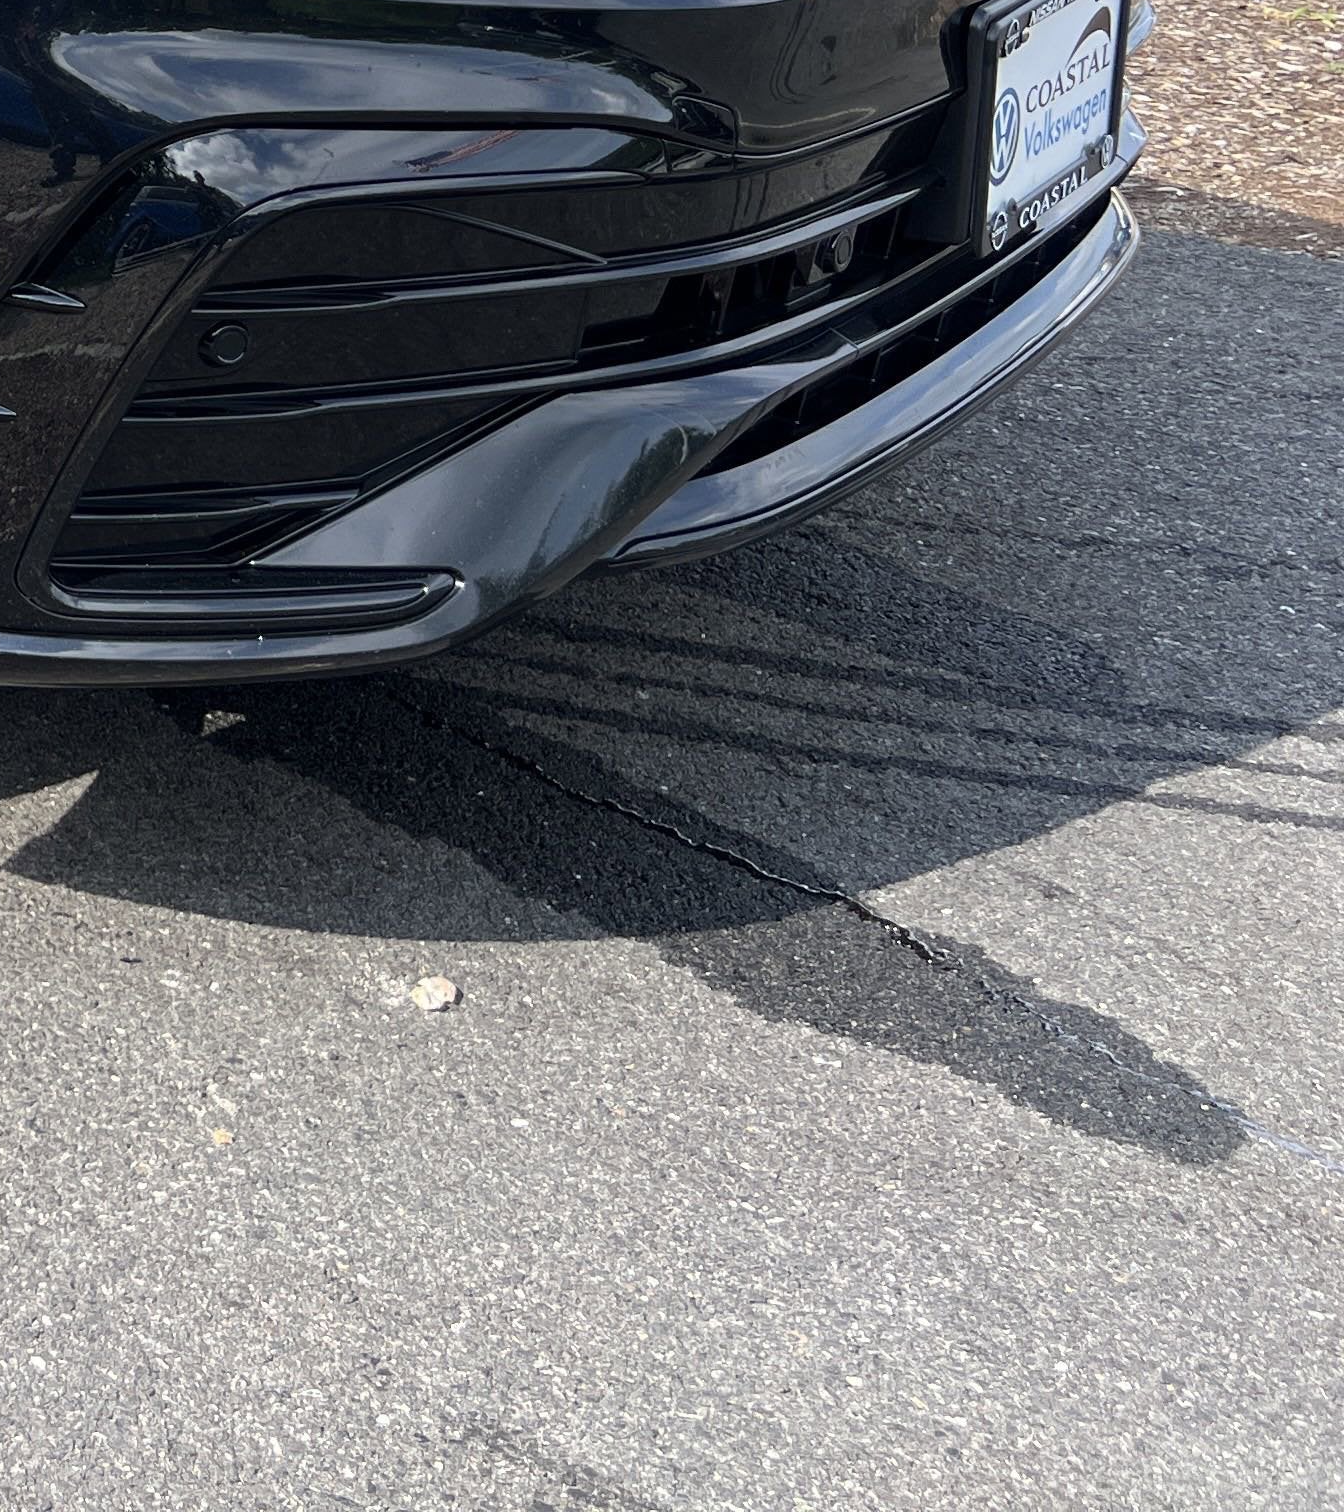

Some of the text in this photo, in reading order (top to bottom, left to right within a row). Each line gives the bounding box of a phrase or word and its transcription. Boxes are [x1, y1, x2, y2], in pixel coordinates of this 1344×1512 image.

[1025, 42, 1111, 113] COASTAL
[990, 87, 1021, 187] VW
[1023, 88, 1107, 161] Volkswagen
[1019, 165, 1088, 229] COASTAL
